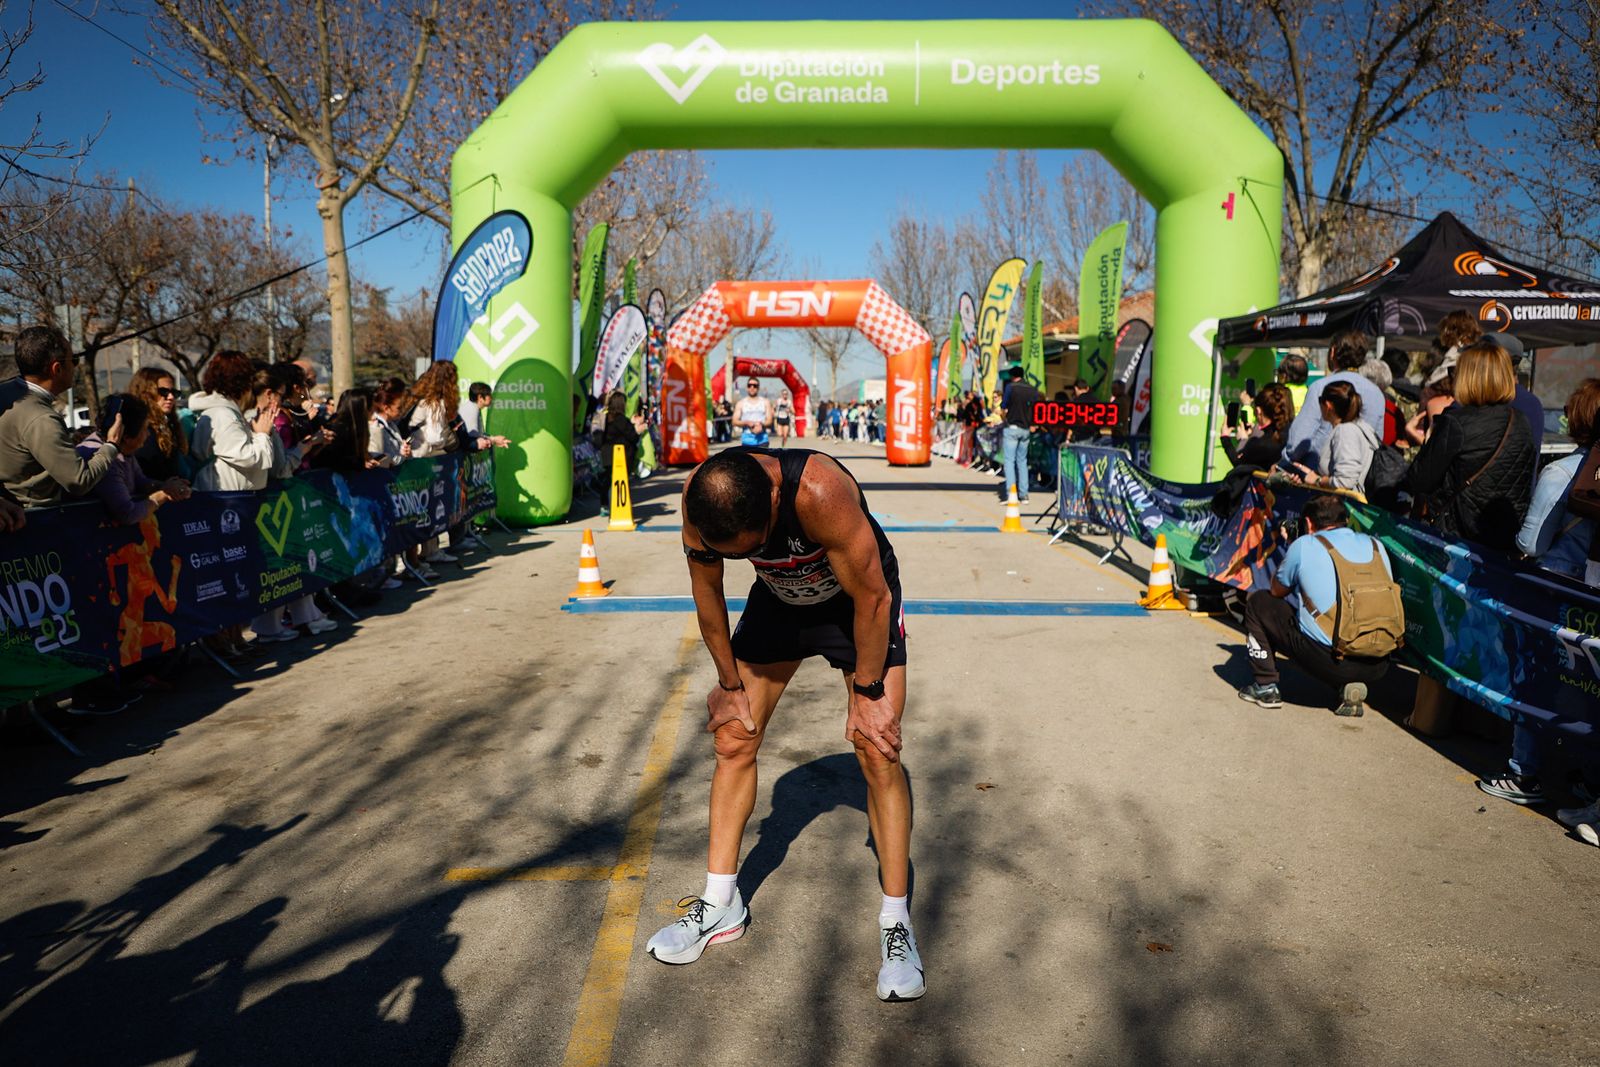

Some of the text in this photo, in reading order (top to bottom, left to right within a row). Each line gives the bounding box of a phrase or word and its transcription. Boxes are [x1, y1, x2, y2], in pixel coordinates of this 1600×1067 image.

[738, 52, 886, 79] Diputación
[950, 57, 1101, 90] Deportes
[735, 80, 889, 104] de Granada
[746, 290, 832, 317] HSN
[666, 379, 688, 449] HSN
[893, 377, 917, 451] HSN
[1033, 403, 1118, 426] 00:34:23
[1178, 401, 1201, 416] de
[614, 479, 627, 508] 10
[182, 520, 211, 534] IDEAL
[260, 561, 302, 587] Diputación
[258, 576, 304, 604] de Granada
